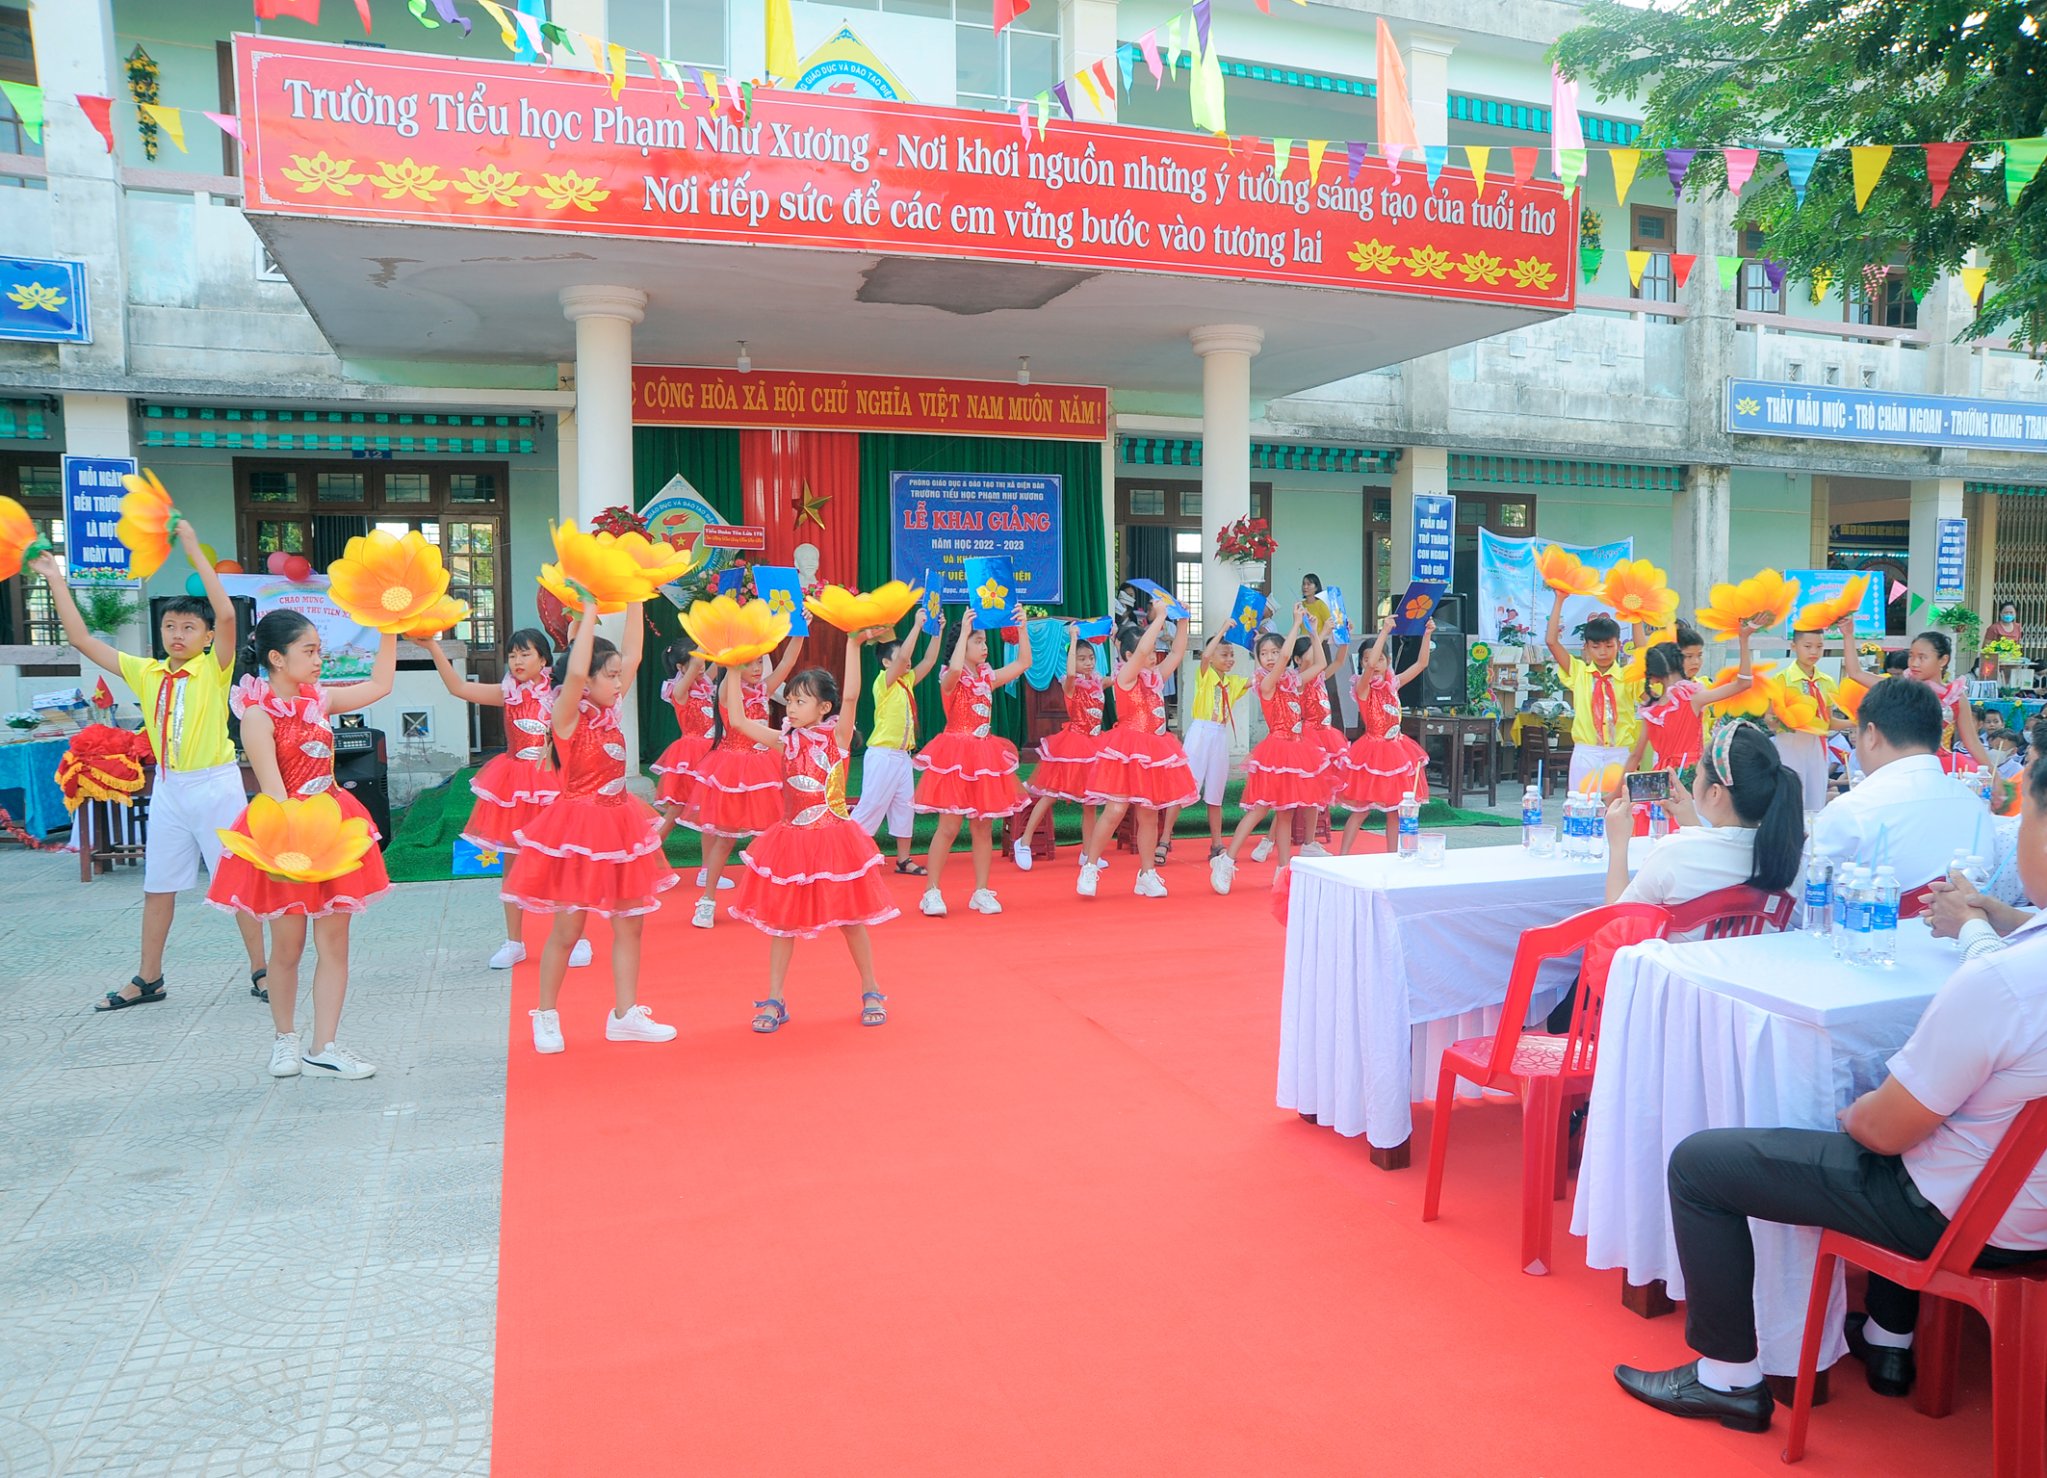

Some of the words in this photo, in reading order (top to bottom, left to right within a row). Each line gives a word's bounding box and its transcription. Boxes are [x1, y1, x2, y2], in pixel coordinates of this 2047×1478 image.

[283, 79, 420, 138] Trường
[428, 82, 510, 136] Tiểu
[518, 98, 583, 150] học
[592, 106, 687, 157] Phạm
[695, 115, 763, 156] Như
[769, 122, 871, 173] Xương
[896, 134, 948, 172] Nơi
[955, 137, 1020, 178] khơi
[1027, 141, 1115, 190] nguồn
[1122, 155, 1208, 204] những
[1214, 162, 1232, 206] ý
[1237, 164, 1312, 216] tưởng
[1316, 179, 1375, 223] sáng
[1380, 191, 1418, 226] tạo
[1423, 187, 1465, 226] của
[1471, 191, 1515, 232] tuổi
[1520, 202, 1557, 238] thơ
[642, 175, 700, 216] Nơi
[708, 171, 770, 228] tiếp
[779, 182, 833, 224] sức
[842, 178, 882, 227] để
[890, 190, 942, 232] các
[951, 203, 996, 236] em
[1003, 201, 1074, 250] vững
[1080, 207, 1150, 249] bước
[1157, 213, 1206, 254] vào
[1212, 222, 1287, 268] tương
[1292, 227, 1324, 265] lai
[643, 375, 695, 414] CỘNG
[700, 377, 739, 410] HÒA
[742, 379, 769, 412] XÃ
[773, 380, 806, 418] HỘI
[811, 379, 849, 414] CHỦ
[856, 386, 913, 416] NGHĨA
[918, 387, 960, 423] VIỆT
[966, 394, 1004, 420] NAM
[1008, 391, 1053, 422] MUÔN
[1059, 393, 1102, 425] NĂM!
[1766, 389, 1794, 424] THẦY
[1796, 391, 1820, 426] MẪU
[1822, 398, 1846, 432] MỰC
[1855, 400, 1875, 430] TRÒ
[1877, 402, 1907, 431] CHĂM
[1909, 408, 1942, 434] NGOAN
[1950, 407, 1988, 437] TRƯỜNG
[1990, 412, 2022, 440] KHANG
[86, 519, 98, 537] LÀ
[904, 501, 928, 530] LỄ
[932, 510, 984, 531] KHAI
[987, 505, 1051, 532] GIẢNG
[108, 547, 125, 563] VUI
[954, 540, 972, 551] HỌC
[973, 540, 995, 551] 2022
[1003, 540, 1025, 551] 2023
